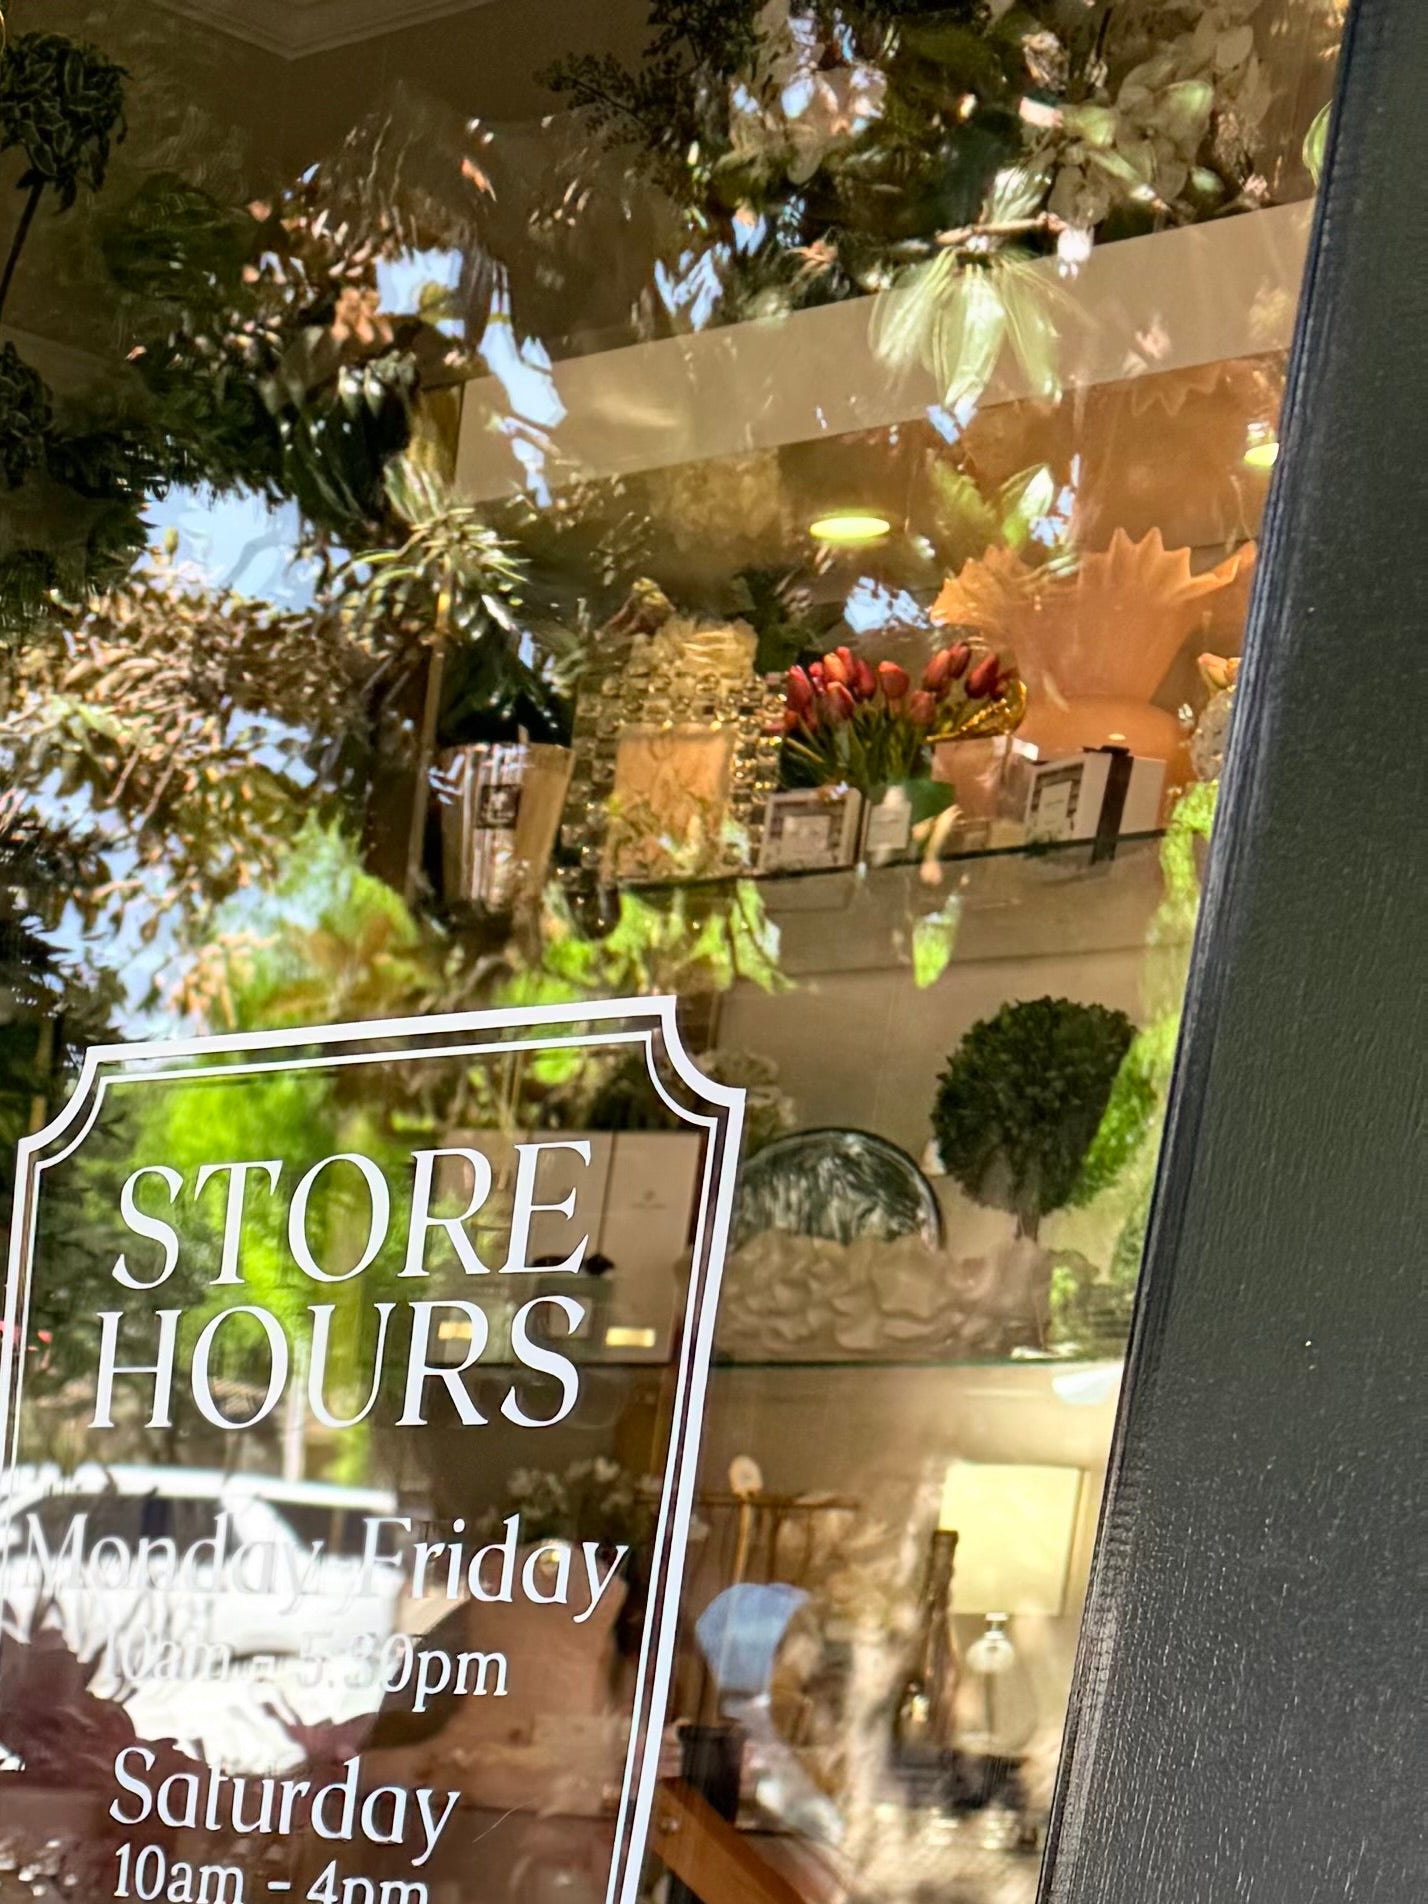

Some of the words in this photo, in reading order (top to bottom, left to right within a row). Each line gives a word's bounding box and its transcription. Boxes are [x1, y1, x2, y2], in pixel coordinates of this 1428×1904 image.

[111, 1139, 593, 1291] STORE
[86, 1294, 587, 1430] HOURS
[22, 1512, 325, 1616] Monday
[360, 1512, 629, 1624] Friday
[108, 1745, 462, 1867] Saturday
[266, 1879, 292, 1892] -
